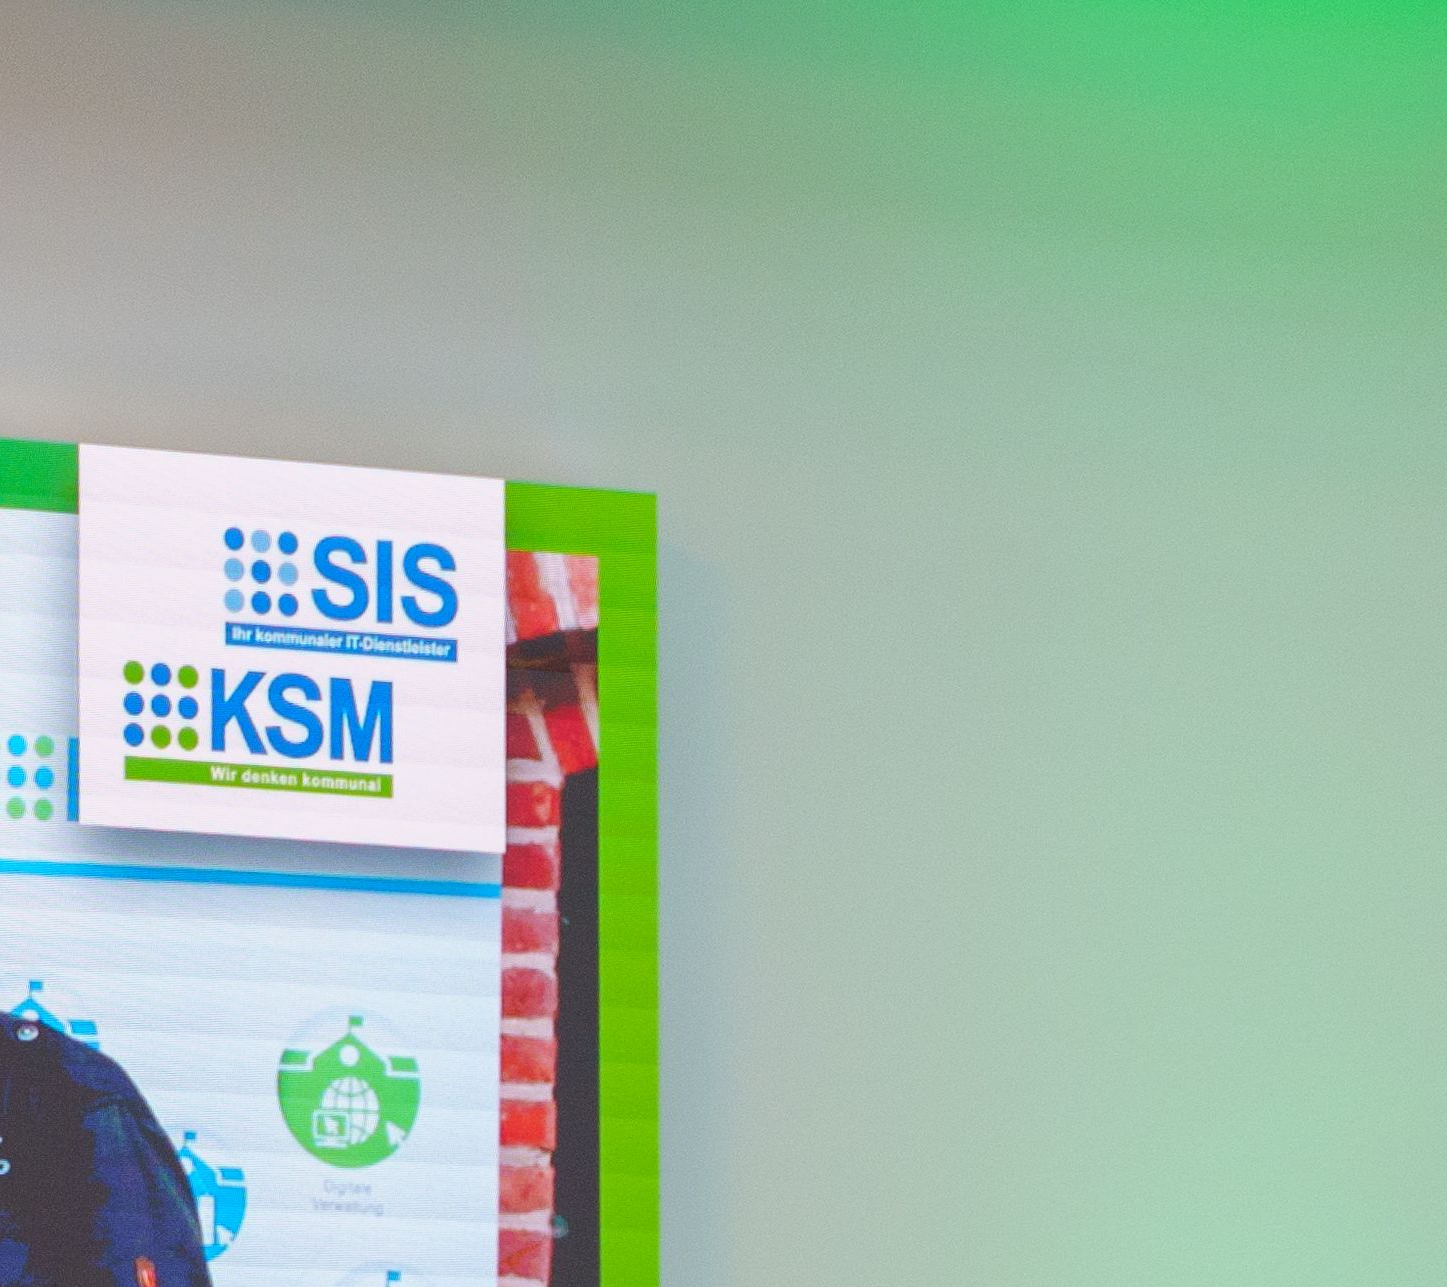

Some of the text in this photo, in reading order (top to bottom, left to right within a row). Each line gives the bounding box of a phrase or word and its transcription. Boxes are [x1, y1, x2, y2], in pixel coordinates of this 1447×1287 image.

[311, 535, 458, 628] SIS
[232, 627, 451, 656] Ihr kommunaler IT-Dienstleister
[211, 668, 393, 764] KSM
[210, 766, 382, 792] Wir denken kommunal
